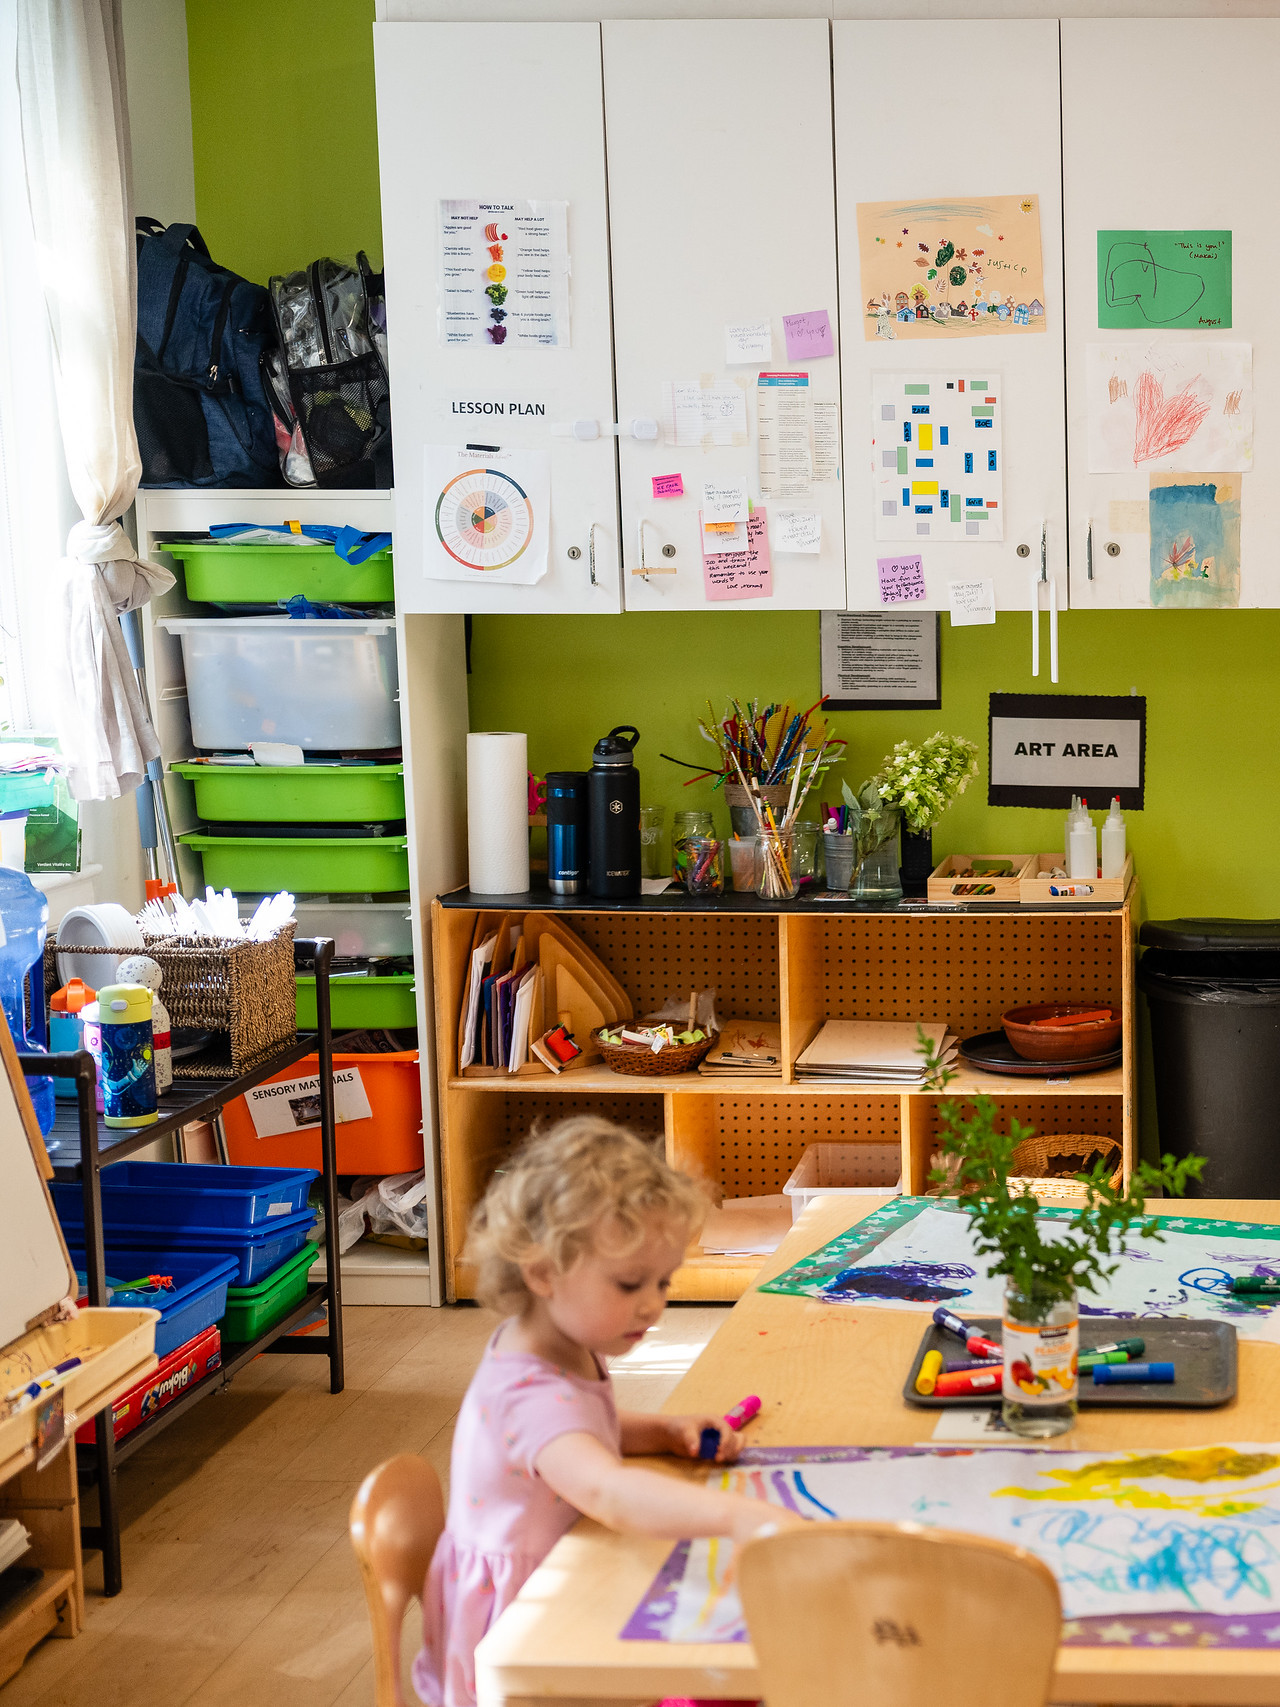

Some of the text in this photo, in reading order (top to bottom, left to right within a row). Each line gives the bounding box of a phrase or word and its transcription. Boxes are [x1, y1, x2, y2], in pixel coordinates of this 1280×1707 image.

[452, 402, 545, 415] LESSON PLAN
[1014, 742, 1119, 758] ART AREA
[252, 1073, 354, 1100] SENSORY MATIALS
[159, 1365, 188, 1398] Blokus
